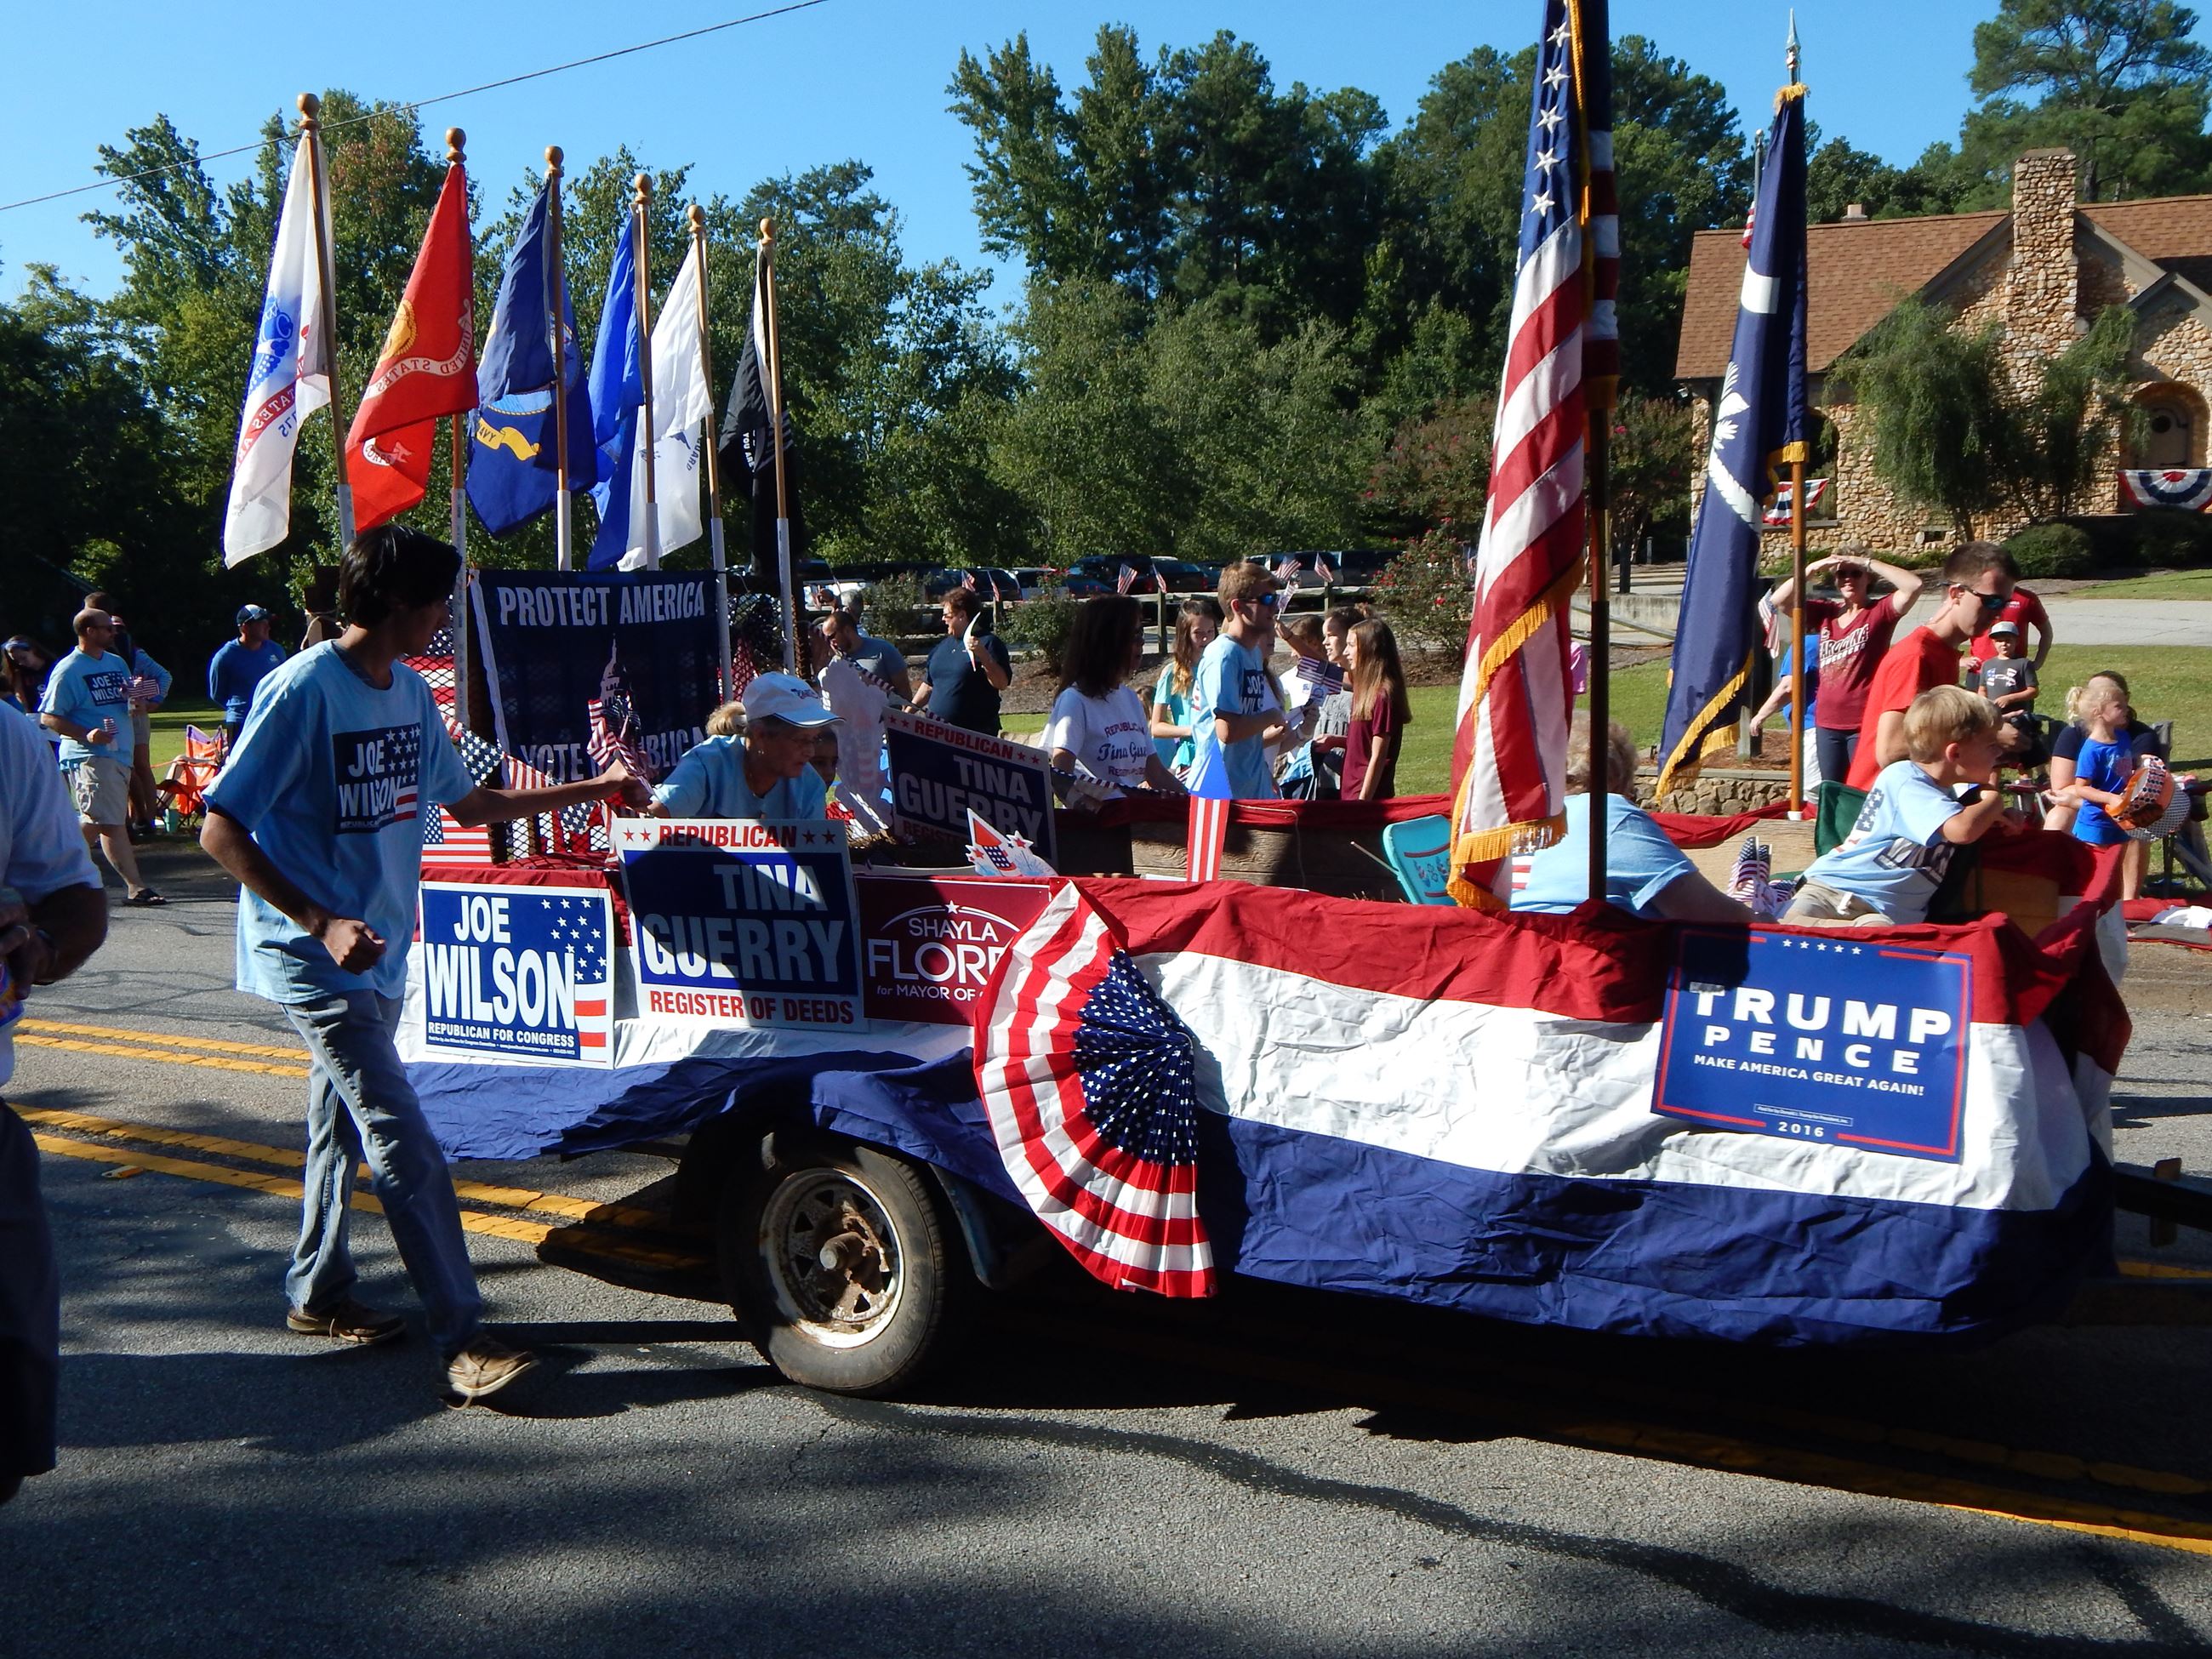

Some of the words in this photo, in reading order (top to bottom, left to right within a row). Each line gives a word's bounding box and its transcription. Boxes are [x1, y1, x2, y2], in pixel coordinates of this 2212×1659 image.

[479, 427, 496, 442] AVY
[742, 432, 750, 449] YOU
[744, 452, 755, 468] ARE
[497, 586, 611, 626] PROTECT
[619, 581, 705, 624] AMERICA
[91, 687, 120, 701] WILSO
[92, 676, 112, 688] JOE
[914, 720, 1013, 760] REPUBLICAN
[1097, 743, 1129, 761] Tina
[347, 739, 385, 778] JOE
[953, 754, 1033, 804] TINA
[898, 772, 1043, 847] GUERRY
[658, 825, 797, 847] REPUBLICAN
[904, 819, 968, 844] REGIST
[713, 864, 829, 911] TINA
[453, 895, 511, 944] JOE
[909, 917, 999, 942] SHAYLA
[641, 914, 845, 983] GUERRY
[425, 943, 575, 1029] WILSON
[877, 984, 892, 995] for
[897, 984, 949, 1000] MAYOR
[954, 988, 976, 1001] OF
[650, 990, 745, 1018] REGISTER
[750, 996, 777, 1020] OF
[784, 999, 854, 1024] DEEDS
[1690, 981, 1952, 1044] TRUMP
[428, 1022, 490, 1040] REPUBLICAN
[493, 1029, 515, 1043] FOR
[516, 1030, 575, 1048] CONGRESS
[1704, 1024, 1920, 1075] PENCE
[1694, 1054, 1736, 1069] MAKE
[1739, 1061, 1808, 1080] AMERICA
[1813, 1071, 1863, 1087] GREAT
[1867, 1079, 1924, 1097] AGAIN!
[1778, 1121, 1825, 1137] 2016
